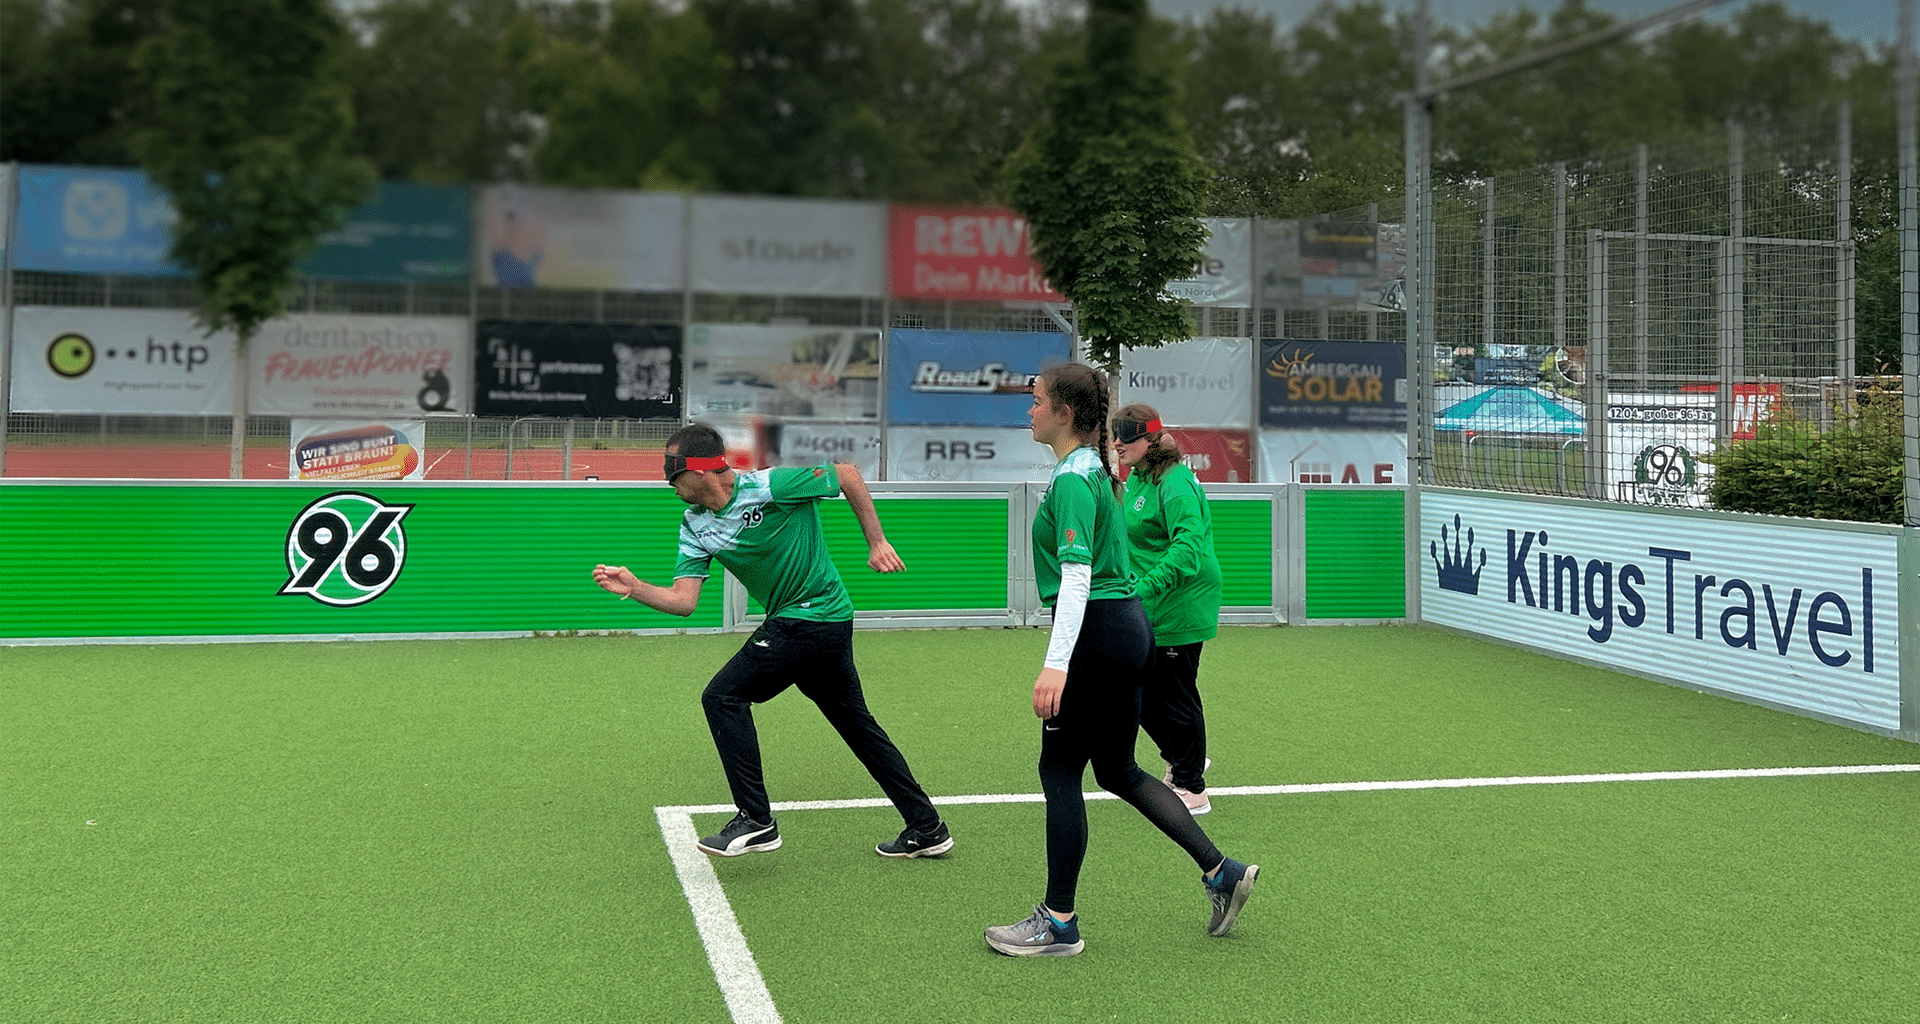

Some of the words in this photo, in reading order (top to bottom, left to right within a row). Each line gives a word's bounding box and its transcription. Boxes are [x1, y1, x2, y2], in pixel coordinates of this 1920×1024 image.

[914, 215, 1035, 257] REW
[914, 262, 971, 292] Dein
[284, 323, 437, 349] dentastico
[147, 337, 209, 373] htp
[1289, 363, 1382, 379] AMBERGAU
[1287, 376, 1382, 402] SOLAR
[1644, 408, 1678, 421] großer
[1681, 409, 1713, 421] 96-Tag
[301, 446, 326, 459] WIR
[329, 441, 359, 455] SIND
[363, 435, 395, 449] BUNT
[303, 455, 340, 470] STATT
[345, 446, 393, 463] BRAUN!
[925, 441, 996, 460] RRS
[1650, 446, 1683, 485] 96
[742, 507, 762, 527] 96
[292, 511, 401, 588] 96
[1506, 529, 1875, 674] KingsTravel
